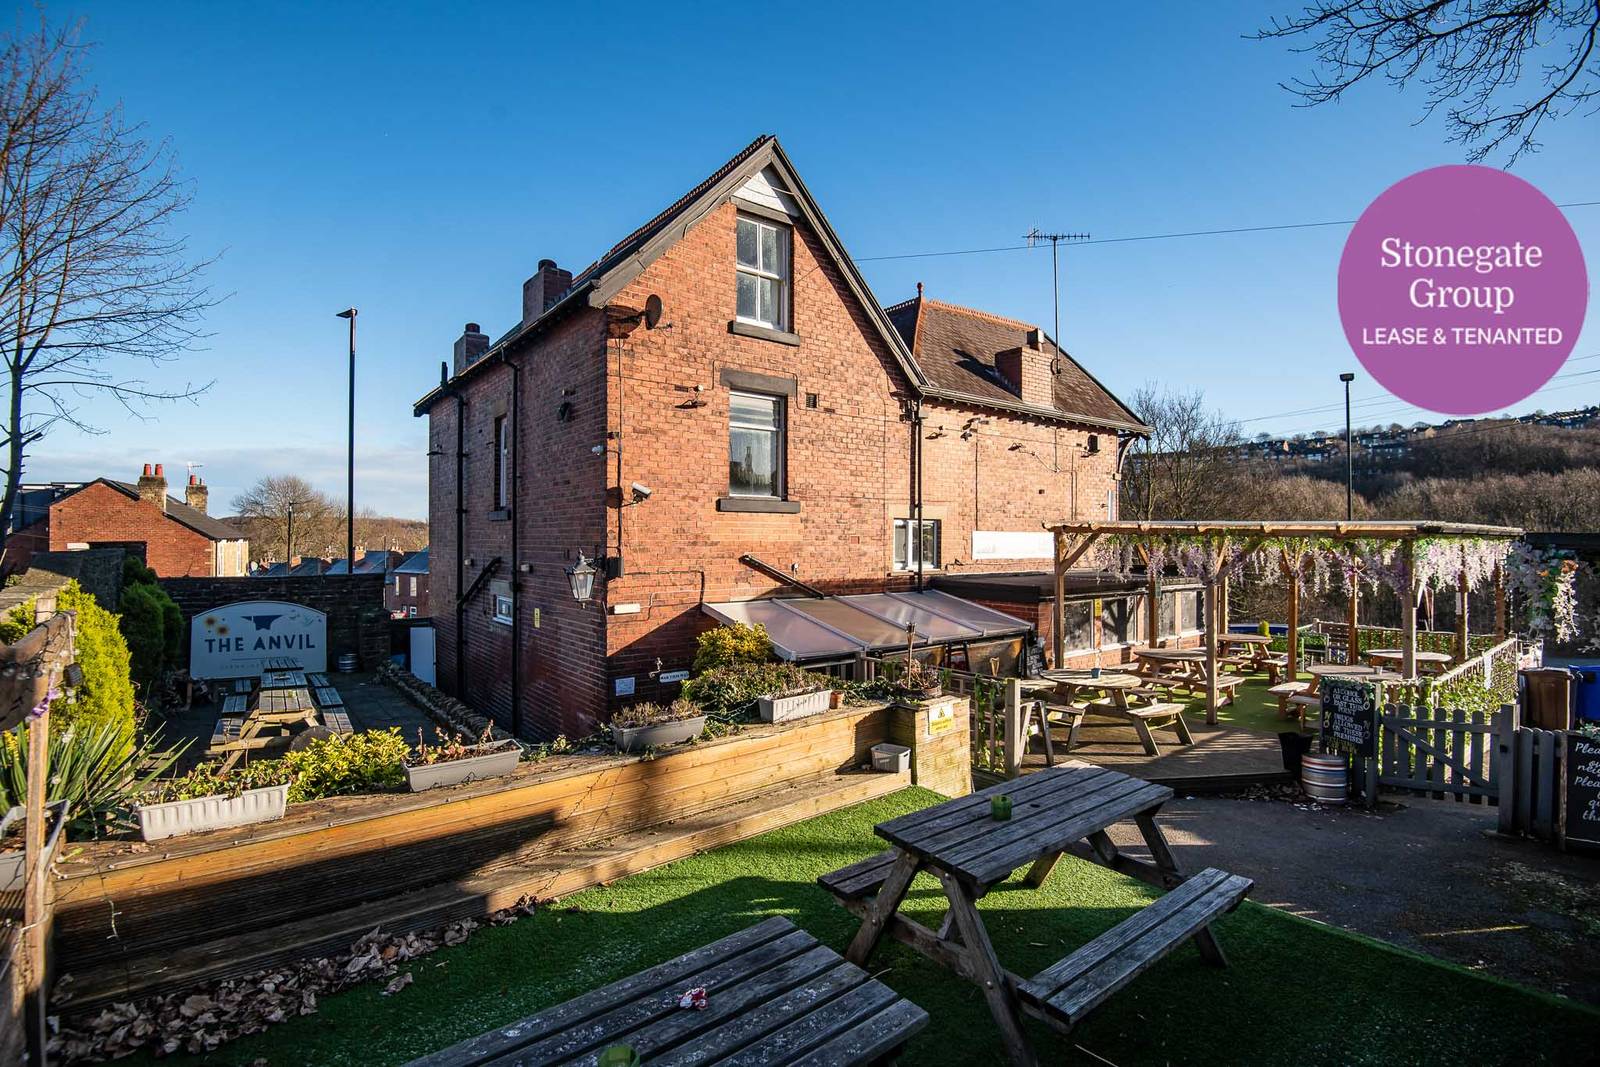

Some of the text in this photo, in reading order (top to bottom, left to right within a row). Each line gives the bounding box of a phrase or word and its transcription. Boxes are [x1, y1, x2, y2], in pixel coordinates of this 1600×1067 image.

[204, 634, 316, 653] THE ANVIL
[1342, 695, 1362, 704] GLASS
